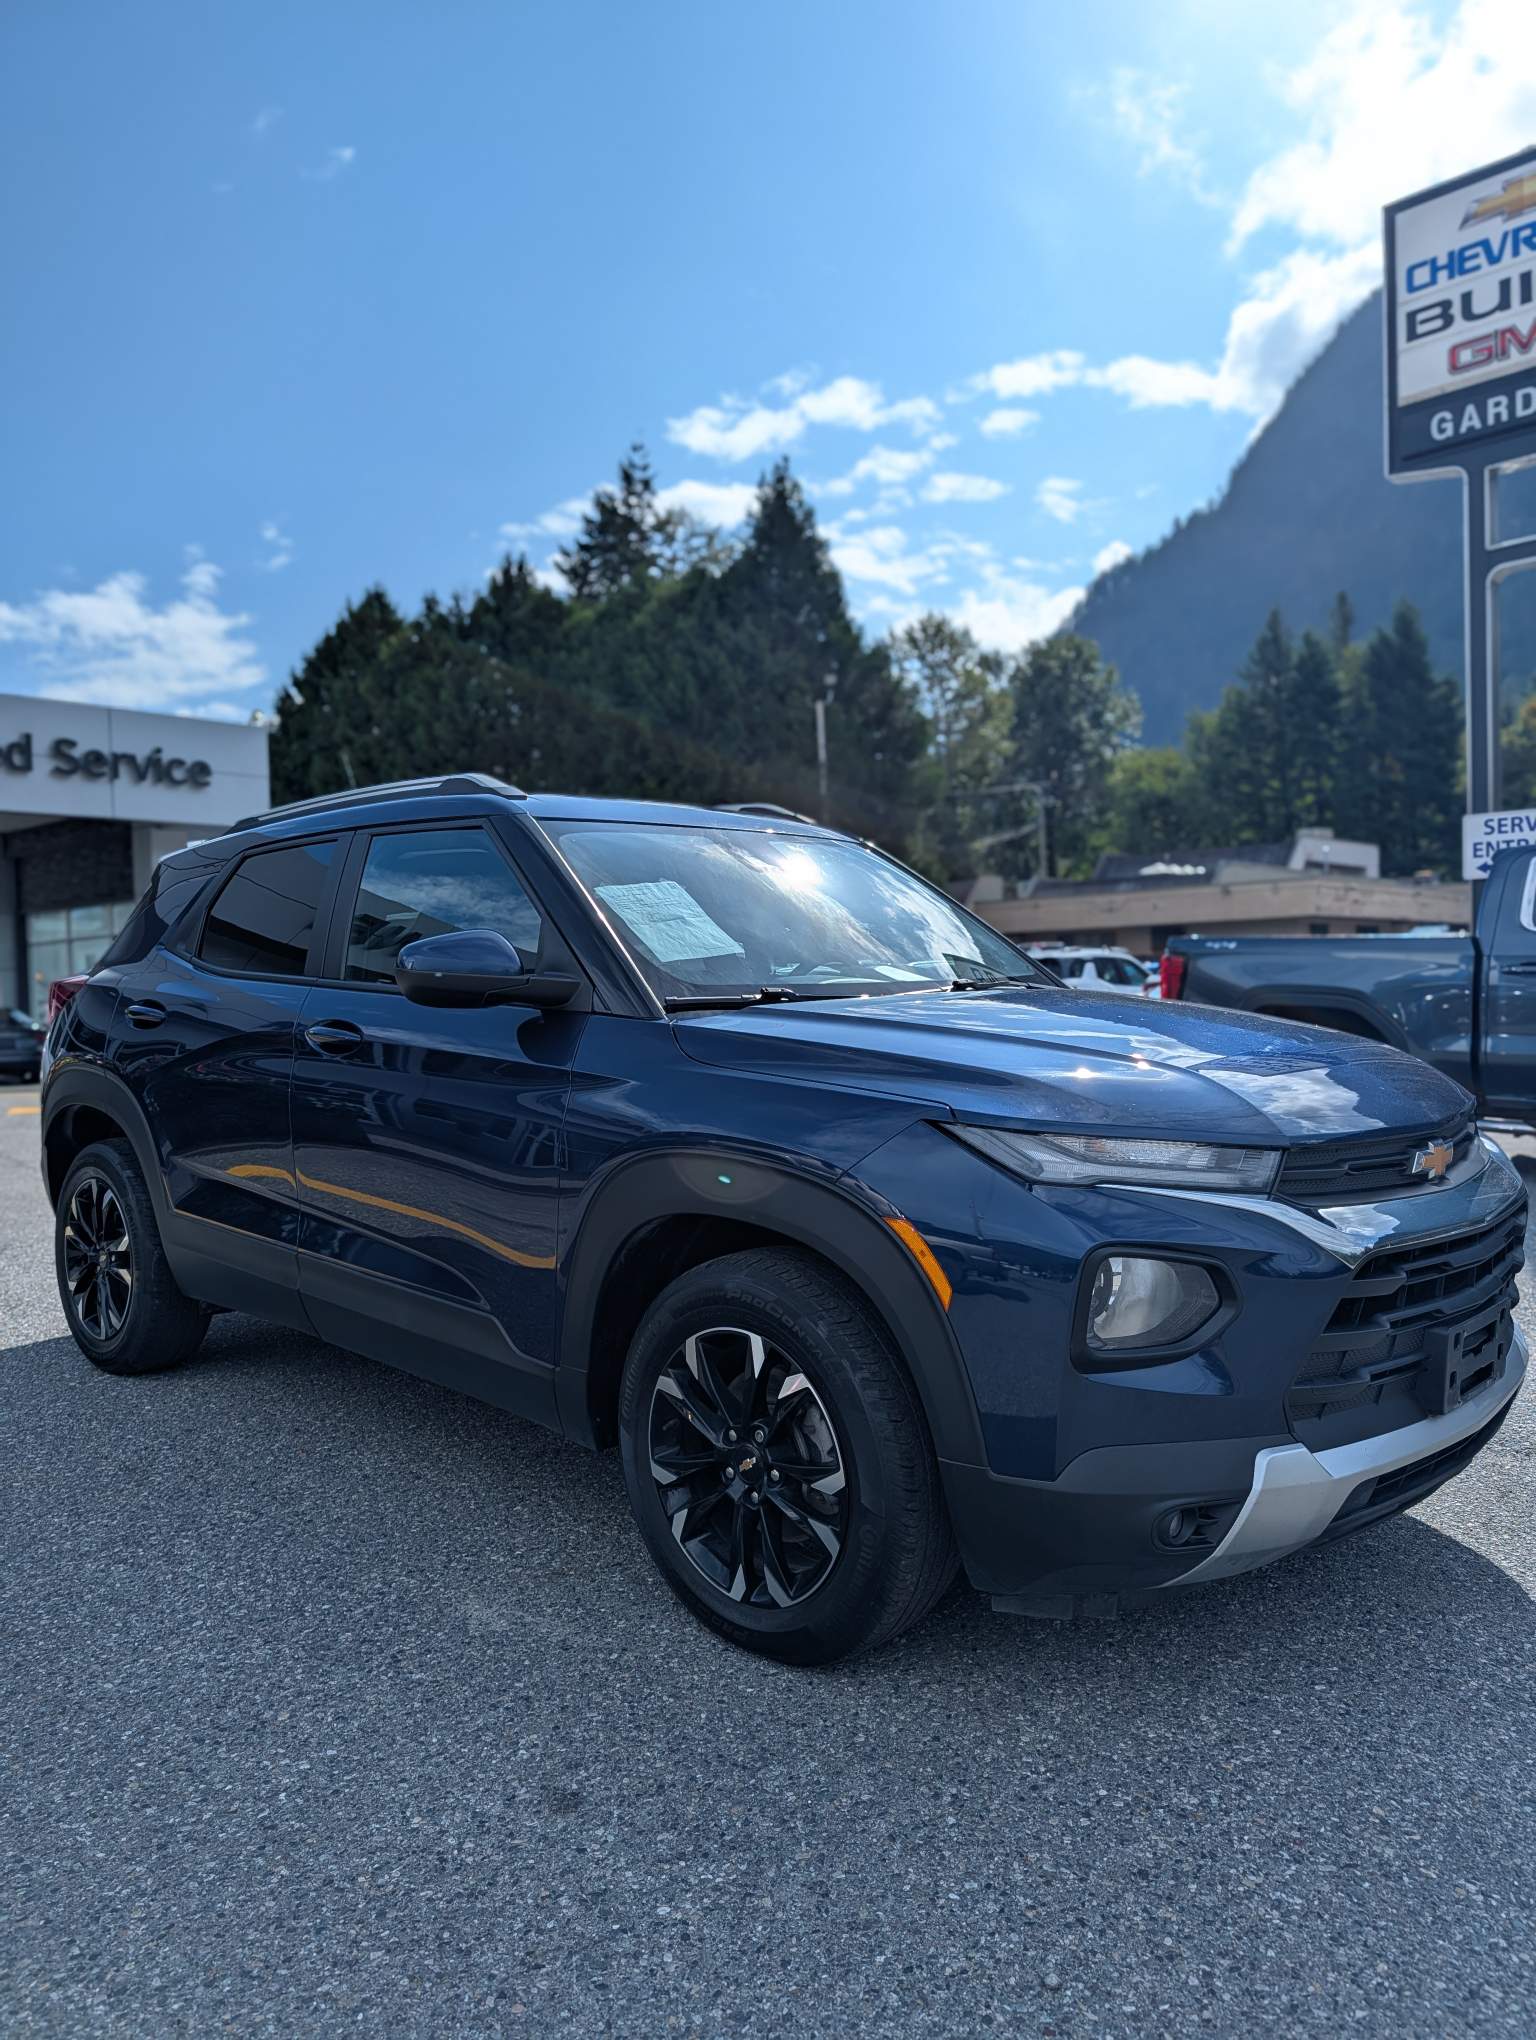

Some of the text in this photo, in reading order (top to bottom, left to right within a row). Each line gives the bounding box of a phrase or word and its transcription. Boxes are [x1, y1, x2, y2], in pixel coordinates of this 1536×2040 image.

[1406, 269, 1533, 343] BUI
[1448, 317, 1536, 375] GM
[1430, 385, 1536, 441] GARD
[0, 733, 212, 788] d Service
[1483, 815, 1536, 835] SERV
